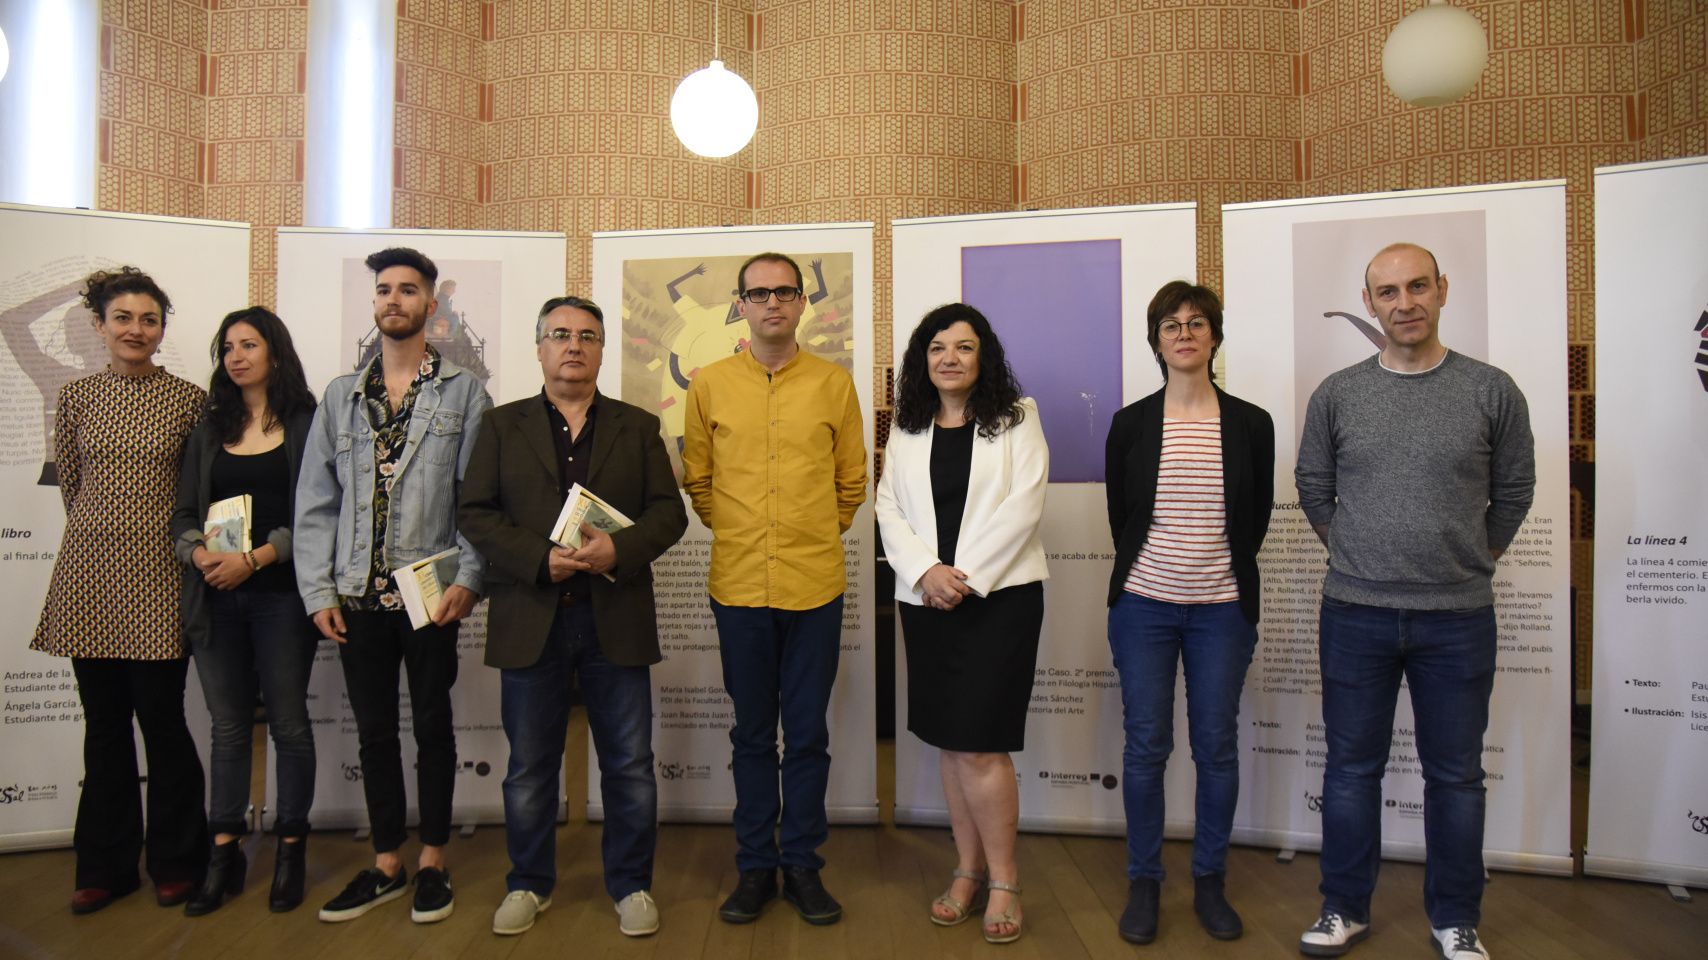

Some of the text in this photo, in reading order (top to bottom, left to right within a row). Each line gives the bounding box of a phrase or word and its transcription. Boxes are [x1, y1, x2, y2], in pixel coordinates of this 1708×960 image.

[1, 527, 31, 539] libro
[1267, 526, 1285, 534] doce
[1521, 527, 1529, 535] la
[1265, 536, 1283, 544] roble
[1533, 538, 1553, 546] de la
[1627, 535, 1688, 546] La línea 4
[1286, 546, 1325, 554] Timberline
[1513, 548, 1552, 557] detective,
[3, 551, 54, 561] al final de
[1061, 551, 1086, 560] acaba
[1088, 551, 1099, 560] de
[1626, 557, 1708, 567] La línea 4 comie
[677, 570, 701, 578] estado
[1263, 566, 1307, 575] culpable del
[1626, 570, 1699, 580] el cementerio.
[675, 580, 704, 589] justa de
[1285, 576, 1318, 585] inspector
[1263, 586, 1276, 594] Mr.
[1278, 586, 1306, 595] Rolland,
[1626, 582, 1706, 593] enfermos con la
[1500, 591, 1553, 600] que llevamos
[1626, 594, 1688, 605] berla vivido.
[670, 601, 696, 610] apartar
[1263, 606, 1317, 615] Efectivamente,
[1263, 616, 1299, 625] capacidad
[1509, 612, 1542, 620] máximo
[684, 622, 702, 631] rojas
[1288, 637, 1315, 645] extraña
[1282, 647, 1312, 655] señorita
[1517, 644, 1553, 654] del pubis
[4, 668, 71, 681] Andrea de la
[1035, 668, 1046, 676] de
[1048, 668, 1072, 677] Caso.
[1086, 669, 1115, 679] premio
[1263, 666, 1297, 674] nalmente
[4, 682, 71, 693] Estudiante de
[1632, 679, 1661, 688] Texto:
[684, 685, 707, 694] Isabel
[692, 696, 722, 704] Facultad
[1050, 694, 1084, 703] Sánchez
[4, 699, 77, 713] Ángela García
[1067, 706, 1085, 715] Arte
[4, 712, 71, 724] Estudiante de
[660, 711, 729, 719] Juan Bautista Juan
[1631, 707, 1708, 720] Ilustración: Isis
[660, 721, 697, 730] Licenciado
[709, 721, 730, 730] Bellas
